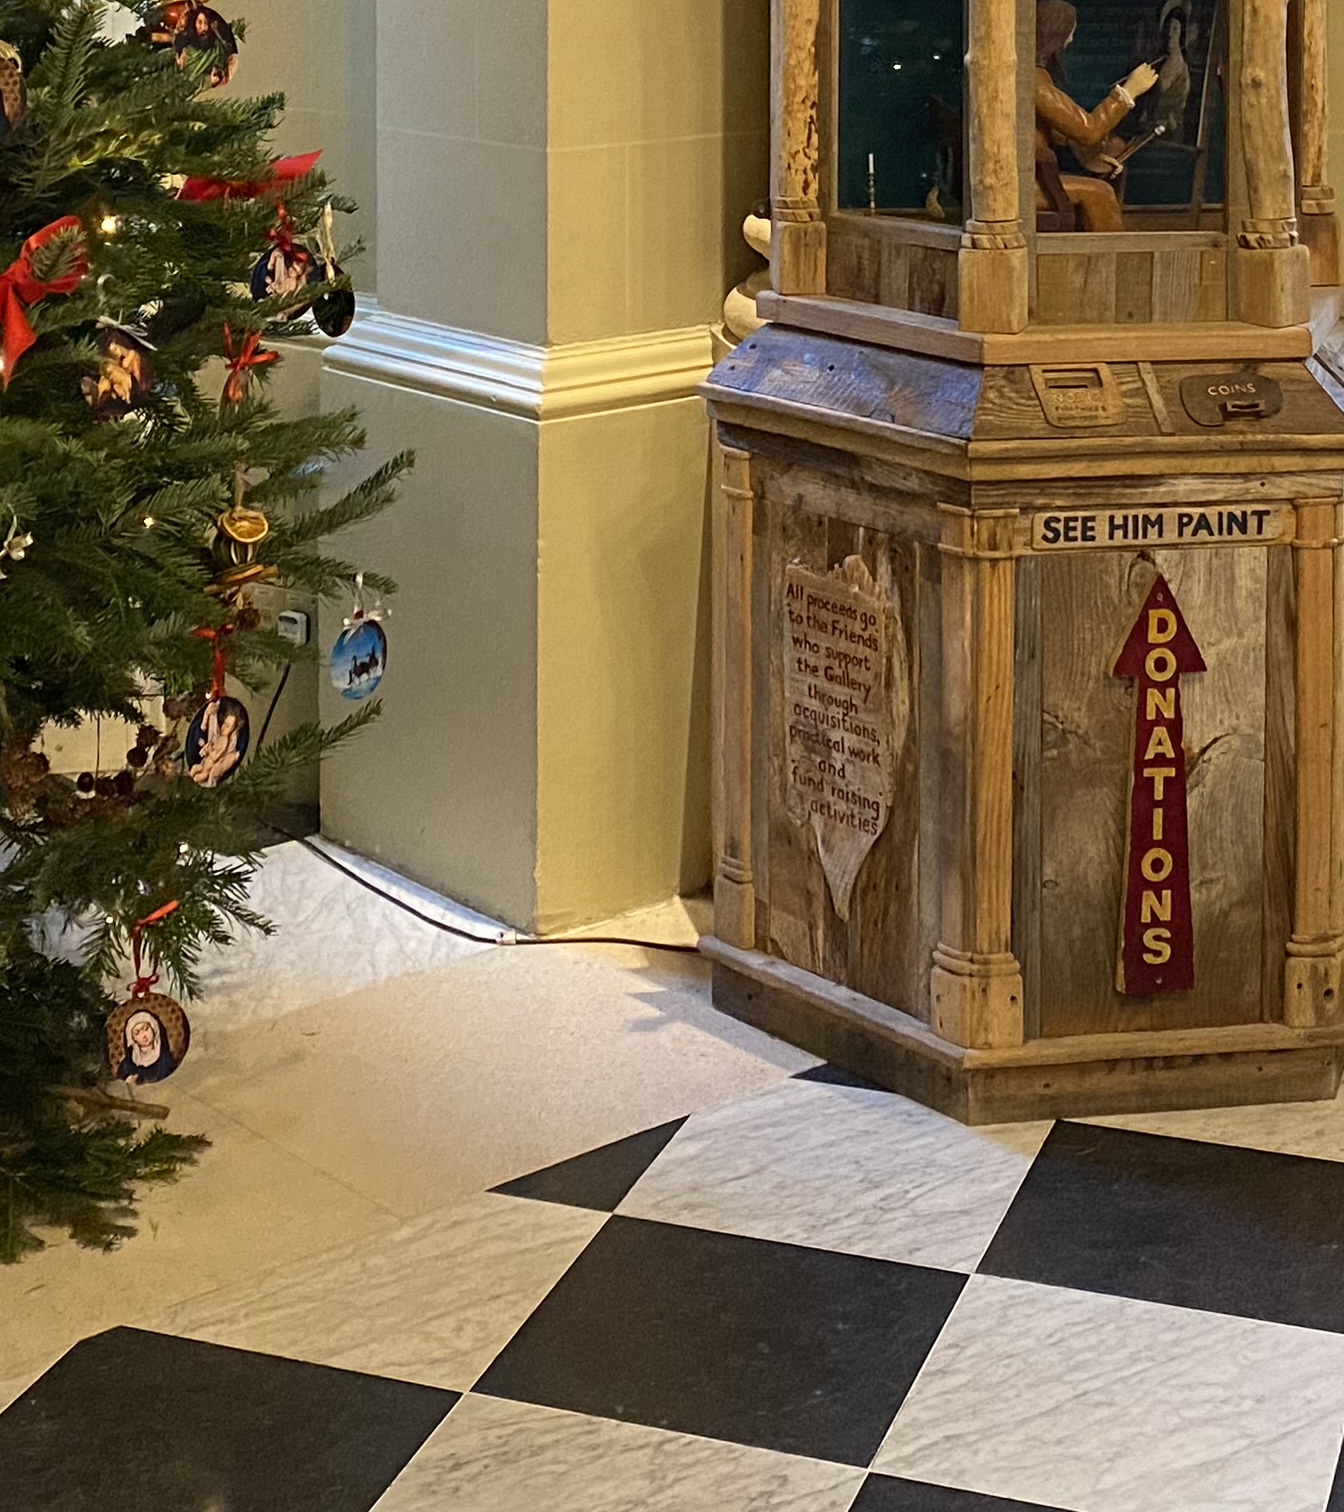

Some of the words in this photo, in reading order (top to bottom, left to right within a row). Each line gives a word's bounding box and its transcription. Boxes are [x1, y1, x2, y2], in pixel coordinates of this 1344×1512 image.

[1207, 382, 1256, 396] COINS
[1041, 515, 1096, 545] SEE
[1108, 512, 1164, 540] HIM
[1177, 509, 1271, 538] PAINT
[786, 583, 803, 601] All
[807, 594, 858, 620] proceeds
[860, 612, 877, 632] go
[788, 608, 803, 625] to
[806, 614, 828, 633] the
[831, 619, 878, 652] Friends
[792, 633, 820, 654] who
[825, 646, 872, 672] support
[796, 657, 819, 675] the
[824, 666, 872, 704] Gallery
[808, 684, 858, 717] through
[789, 724, 845, 755] practical
[848, 744, 881, 768] work
[793, 702, 881, 747] acquisitions,
[818, 759, 846, 779] and
[1140, 607, 1178, 965] DONATIONS
[791, 765, 824, 793] fund
[832, 785, 880, 821] raising
[810, 799, 878, 836] activities
